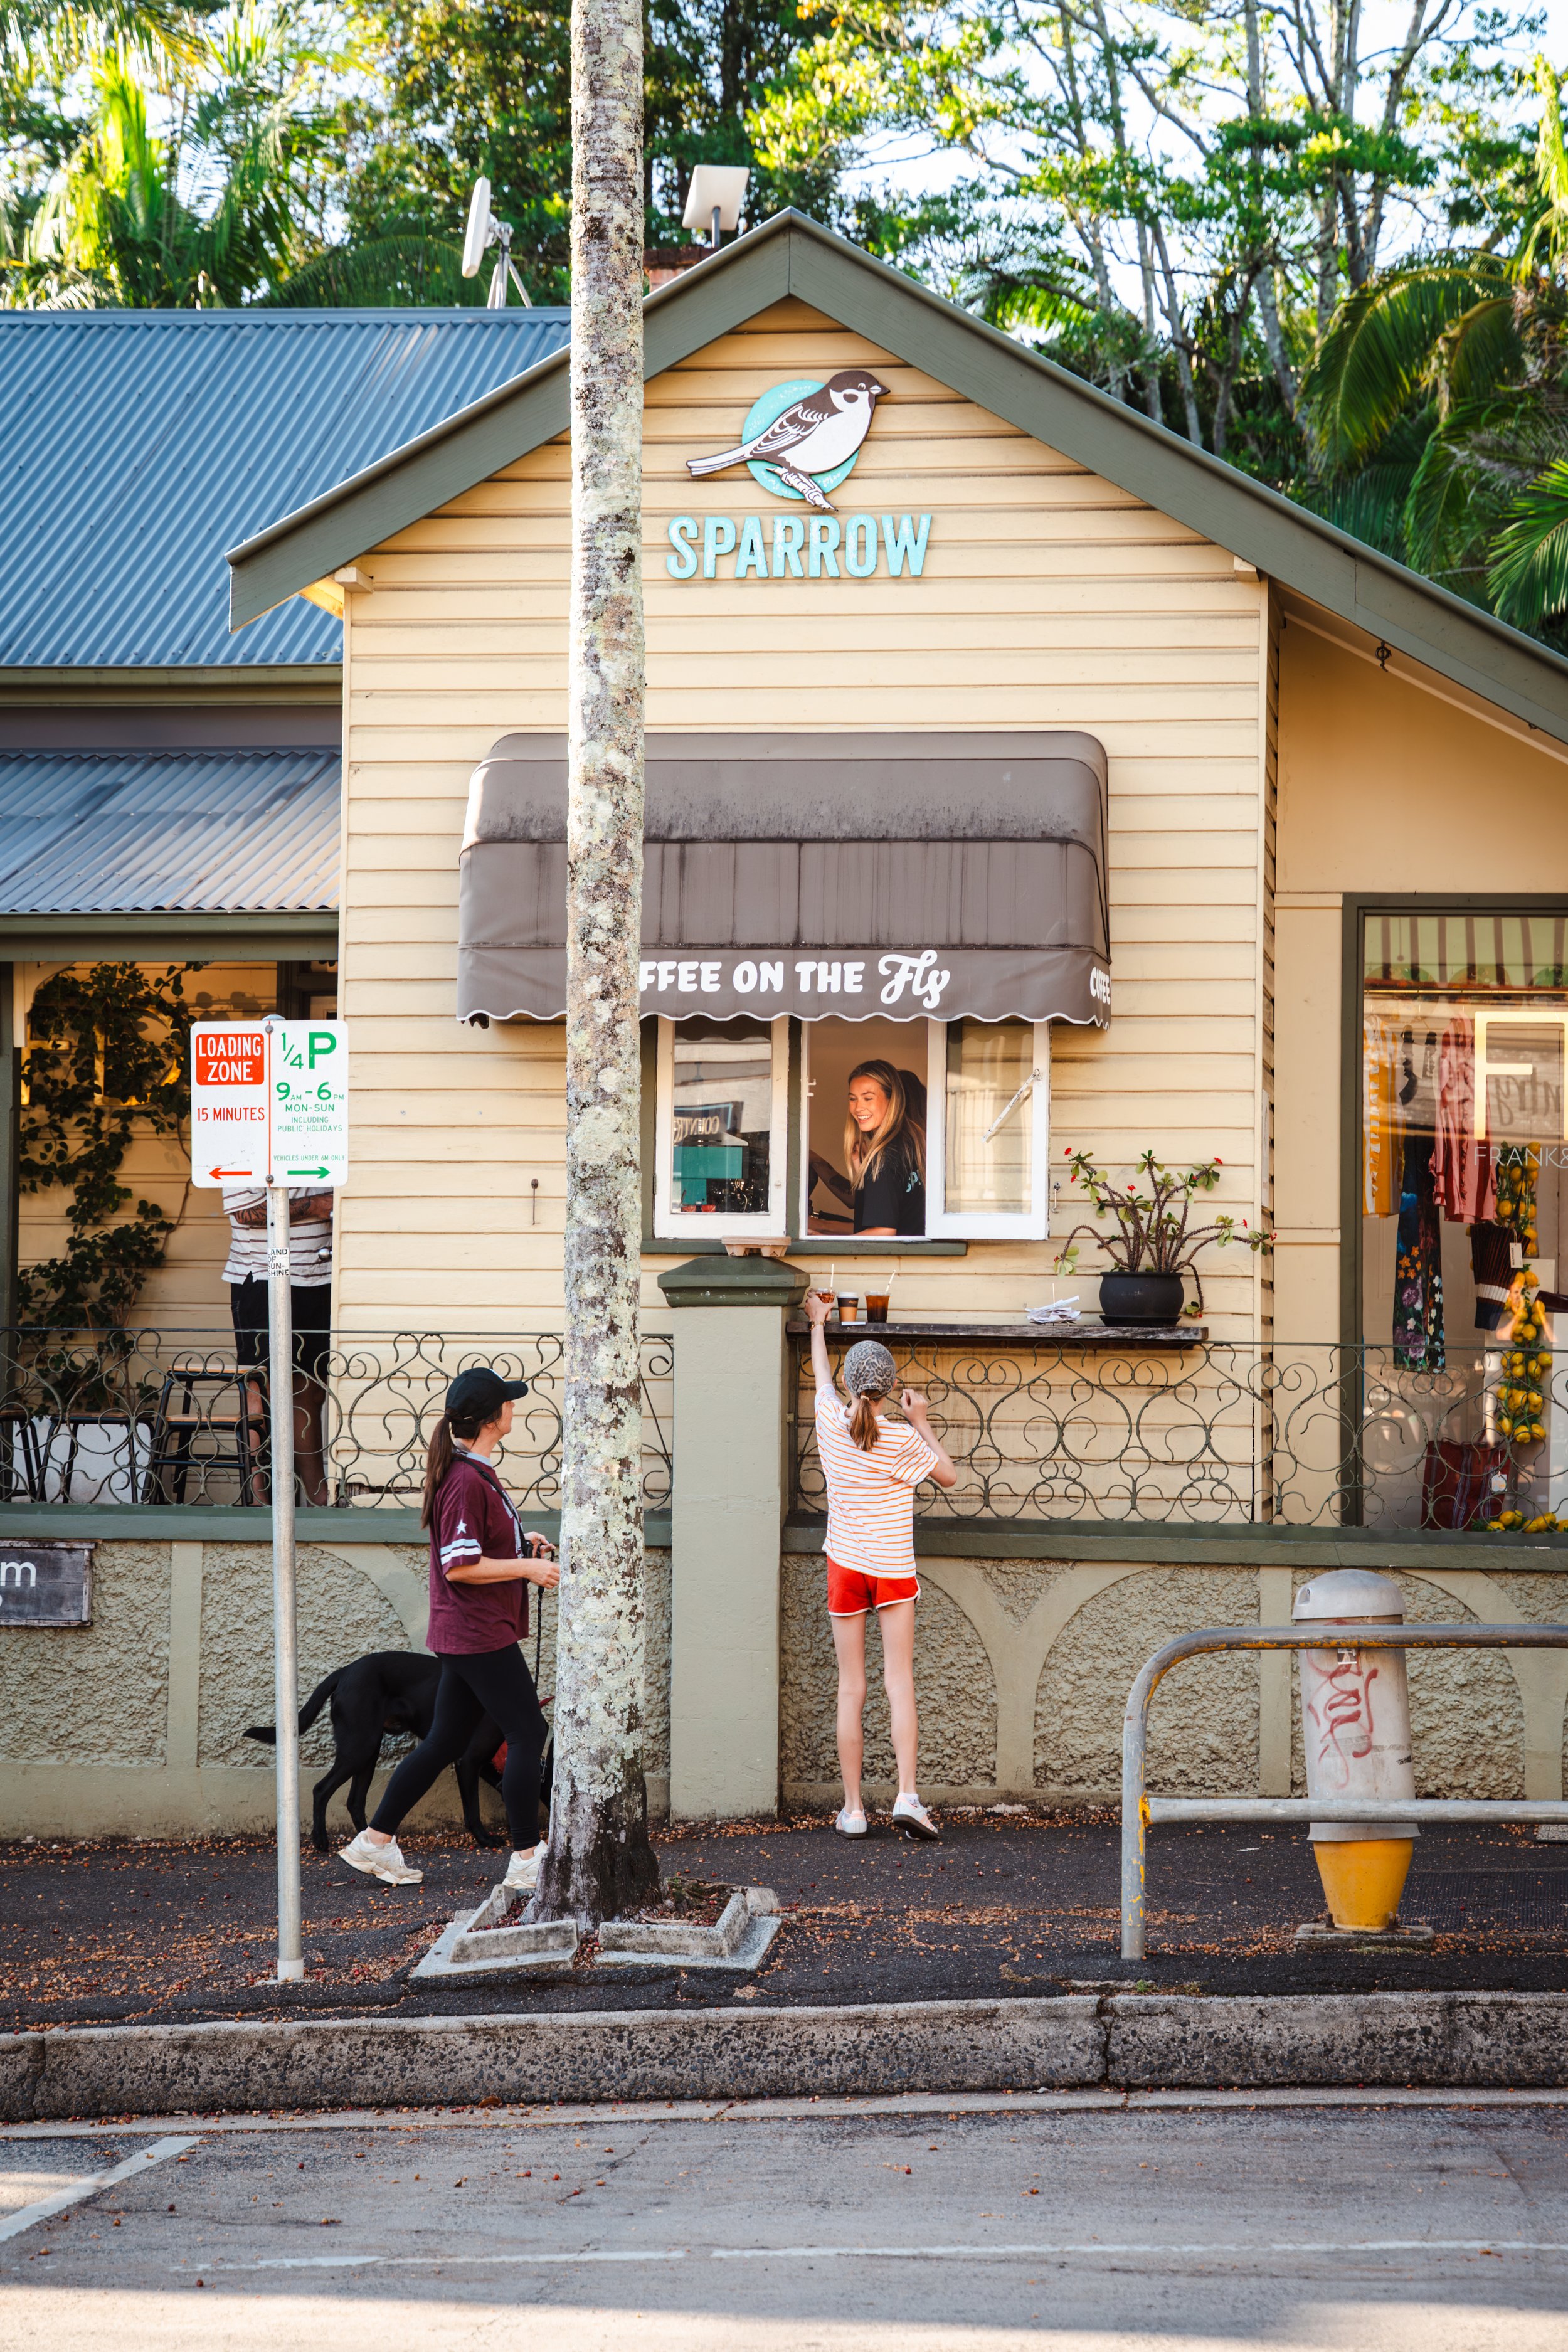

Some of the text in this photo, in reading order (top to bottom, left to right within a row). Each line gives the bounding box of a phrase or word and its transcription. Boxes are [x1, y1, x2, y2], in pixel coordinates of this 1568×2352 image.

[667, 514, 932, 579] SPARROW
[733, 961, 784, 993] ON
[795, 961, 866, 993] THE
[878, 950, 951, 1009] Fly
[198, 1036, 262, 1057] LOADING
[208, 1061, 253, 1082] ZONE
[197, 1107, 265, 1121] 15 MINUTES
[285, 1104, 335, 1112] MON-SUN
